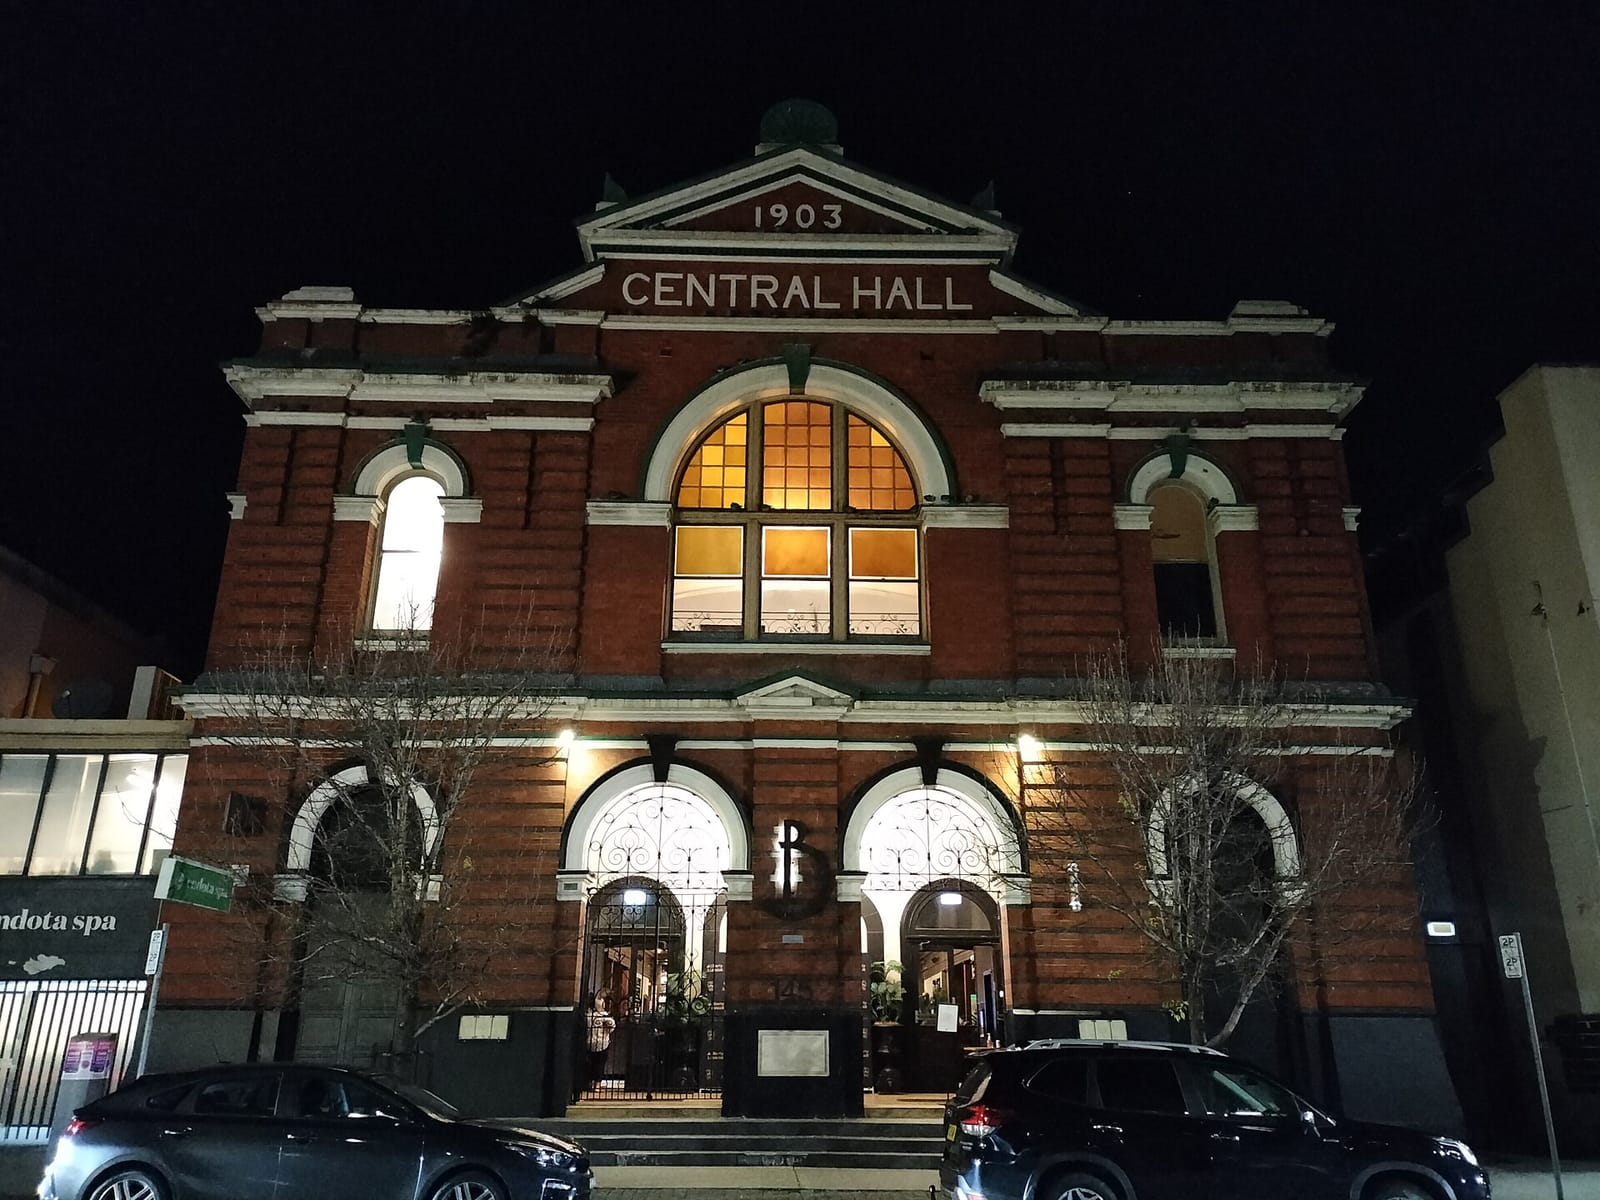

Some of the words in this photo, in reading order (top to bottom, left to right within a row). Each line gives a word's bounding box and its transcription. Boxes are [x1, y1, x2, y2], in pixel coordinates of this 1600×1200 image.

[754, 203, 842, 229] 1903
[621, 271, 841, 310] CENTRAL
[852, 275, 974, 311] HALL
[71, 914, 117, 937] spa
